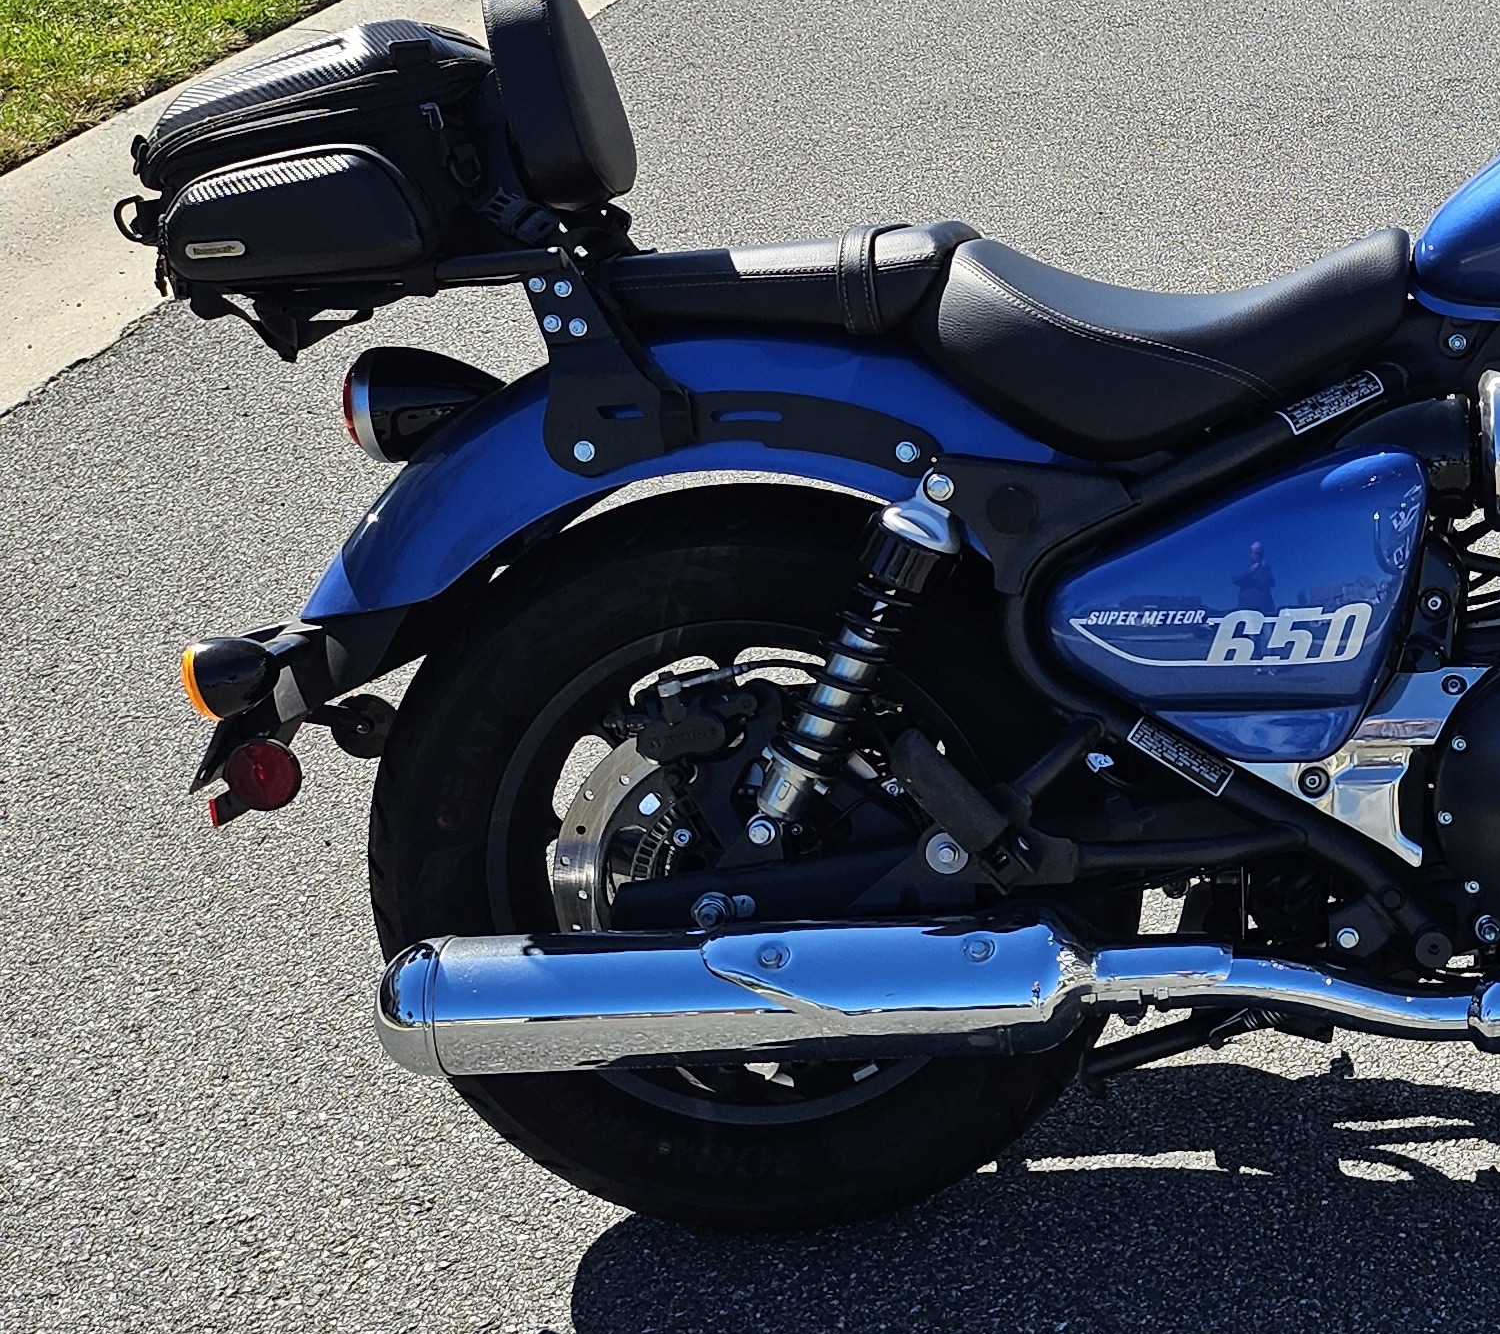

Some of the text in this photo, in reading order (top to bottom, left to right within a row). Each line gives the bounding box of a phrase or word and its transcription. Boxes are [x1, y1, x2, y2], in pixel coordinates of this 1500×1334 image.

[1086, 602, 1374, 664] SUPER METEOR 650
